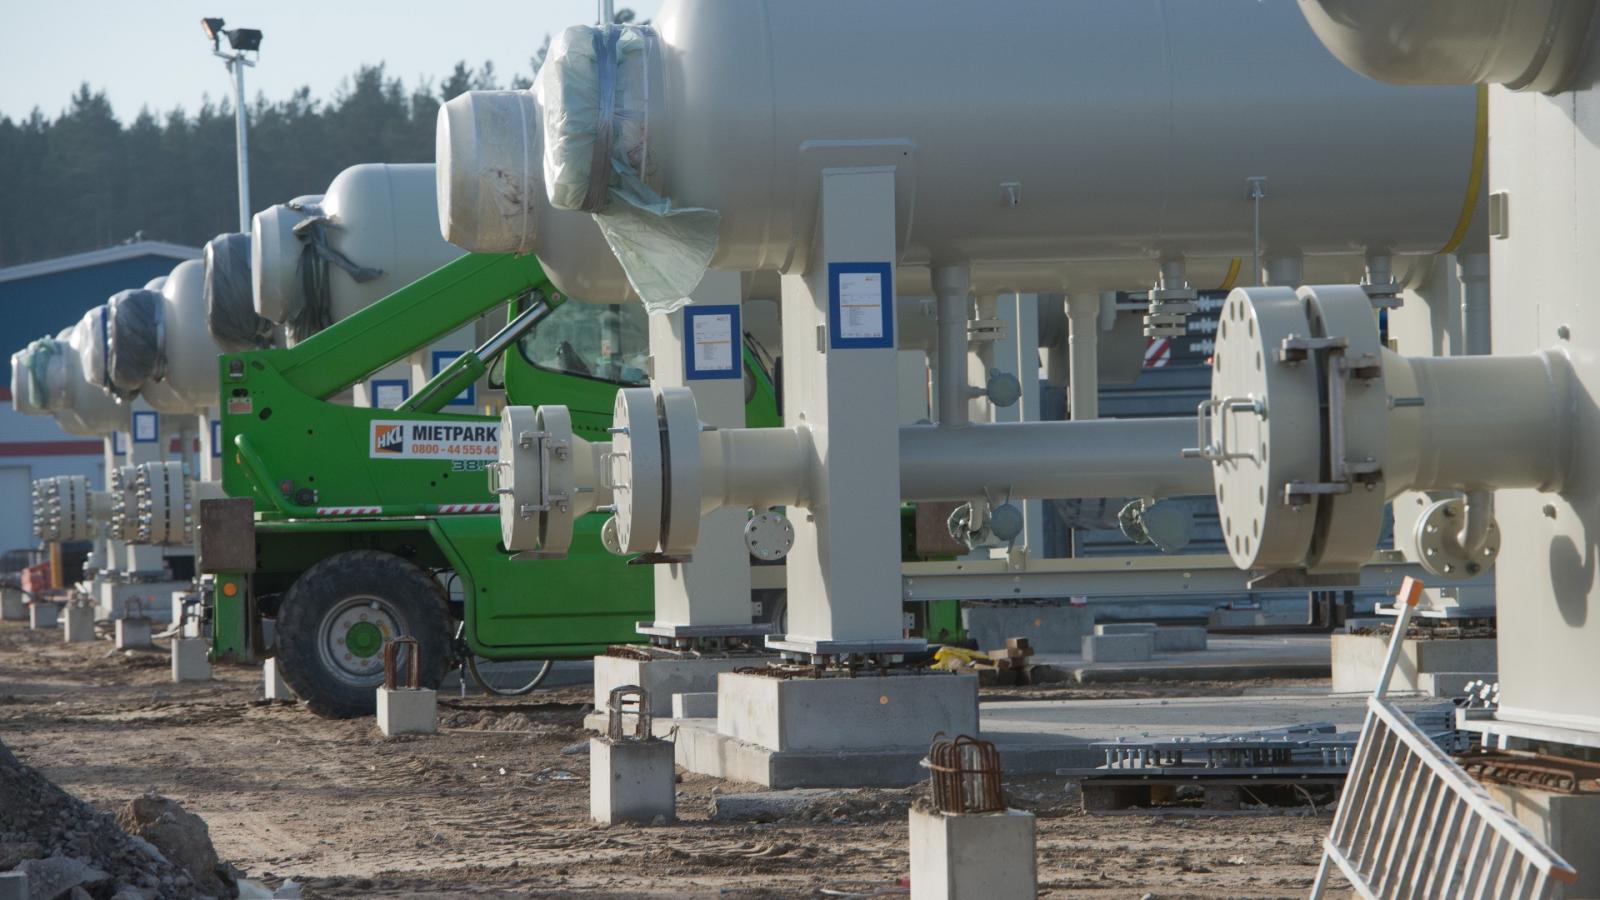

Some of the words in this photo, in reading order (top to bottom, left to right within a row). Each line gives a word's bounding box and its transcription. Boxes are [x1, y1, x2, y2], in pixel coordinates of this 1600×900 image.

[377, 425, 402, 449] HKL
[412, 425, 498, 442] MIETPARK
[412, 443, 439, 454] 0800
[447, 444, 461, 455] 44
[463, 445, 482, 455] 555
[484, 445, 498, 455] 44
